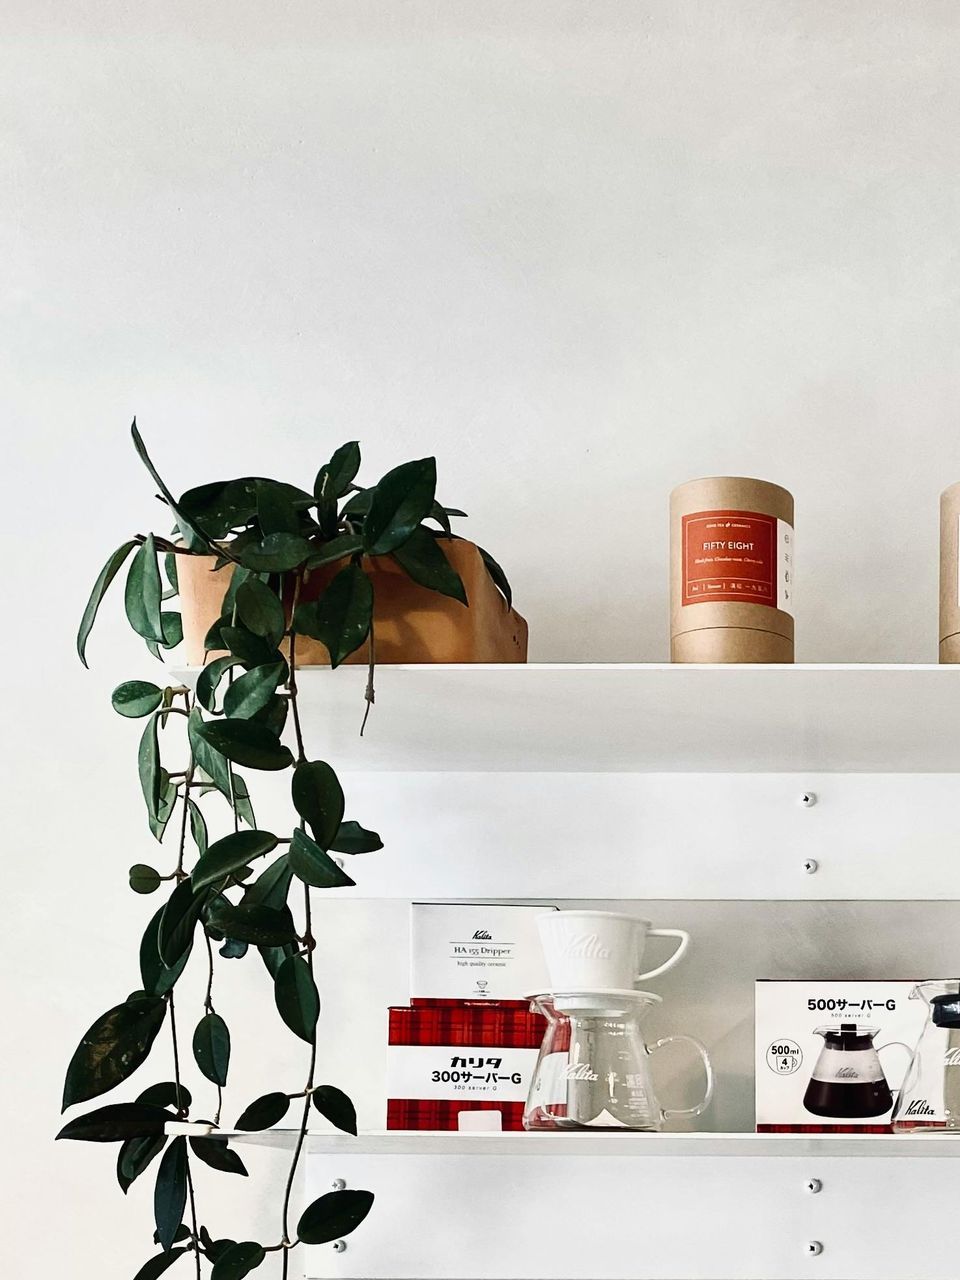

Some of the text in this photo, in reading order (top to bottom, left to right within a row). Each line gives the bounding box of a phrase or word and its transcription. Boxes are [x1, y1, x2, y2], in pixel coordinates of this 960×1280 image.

[703, 541, 755, 551] FIFTY EIGHT
[471, 930, 493, 940] Kalita
[453, 946, 467, 954] HA
[480, 946, 511, 957] Dripper
[807, 999, 896, 1011] 500サーバーG
[771, 1045, 799, 1055] 500ml
[450, 1056, 503, 1069] カリタ
[781, 1057, 788, 1066] 4
[431, 1070, 522, 1084] 300サーバーG
[905, 1100, 936, 1116] Kalita
